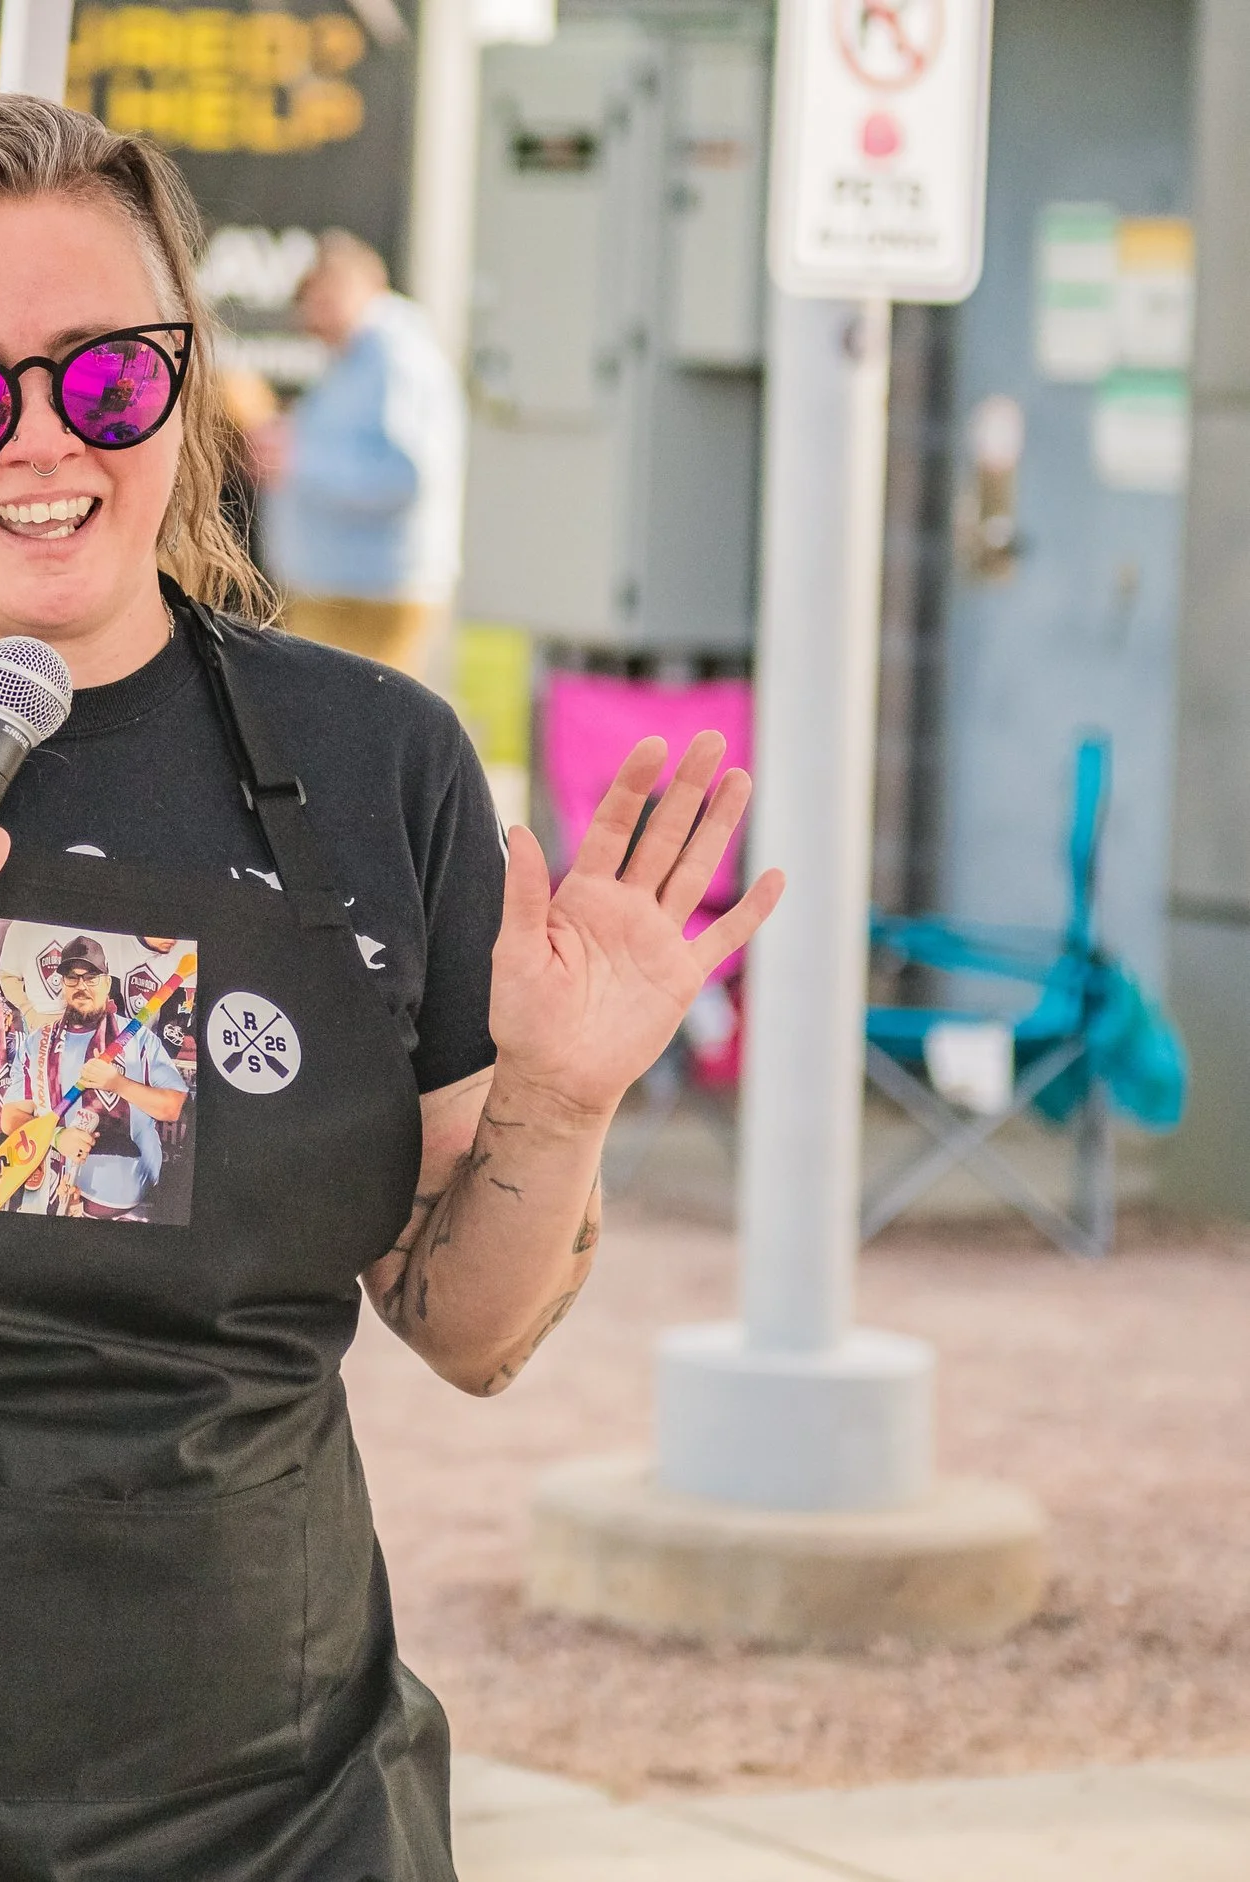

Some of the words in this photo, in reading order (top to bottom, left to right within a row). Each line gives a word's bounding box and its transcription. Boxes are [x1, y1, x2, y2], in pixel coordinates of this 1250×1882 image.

[2, 724, 30, 750] SHURE
[243, 1011, 258, 1031] R
[222, 1029, 240, 1047] 81
[264, 1035, 287, 1052] 26
[248, 1055, 261, 1073] S
